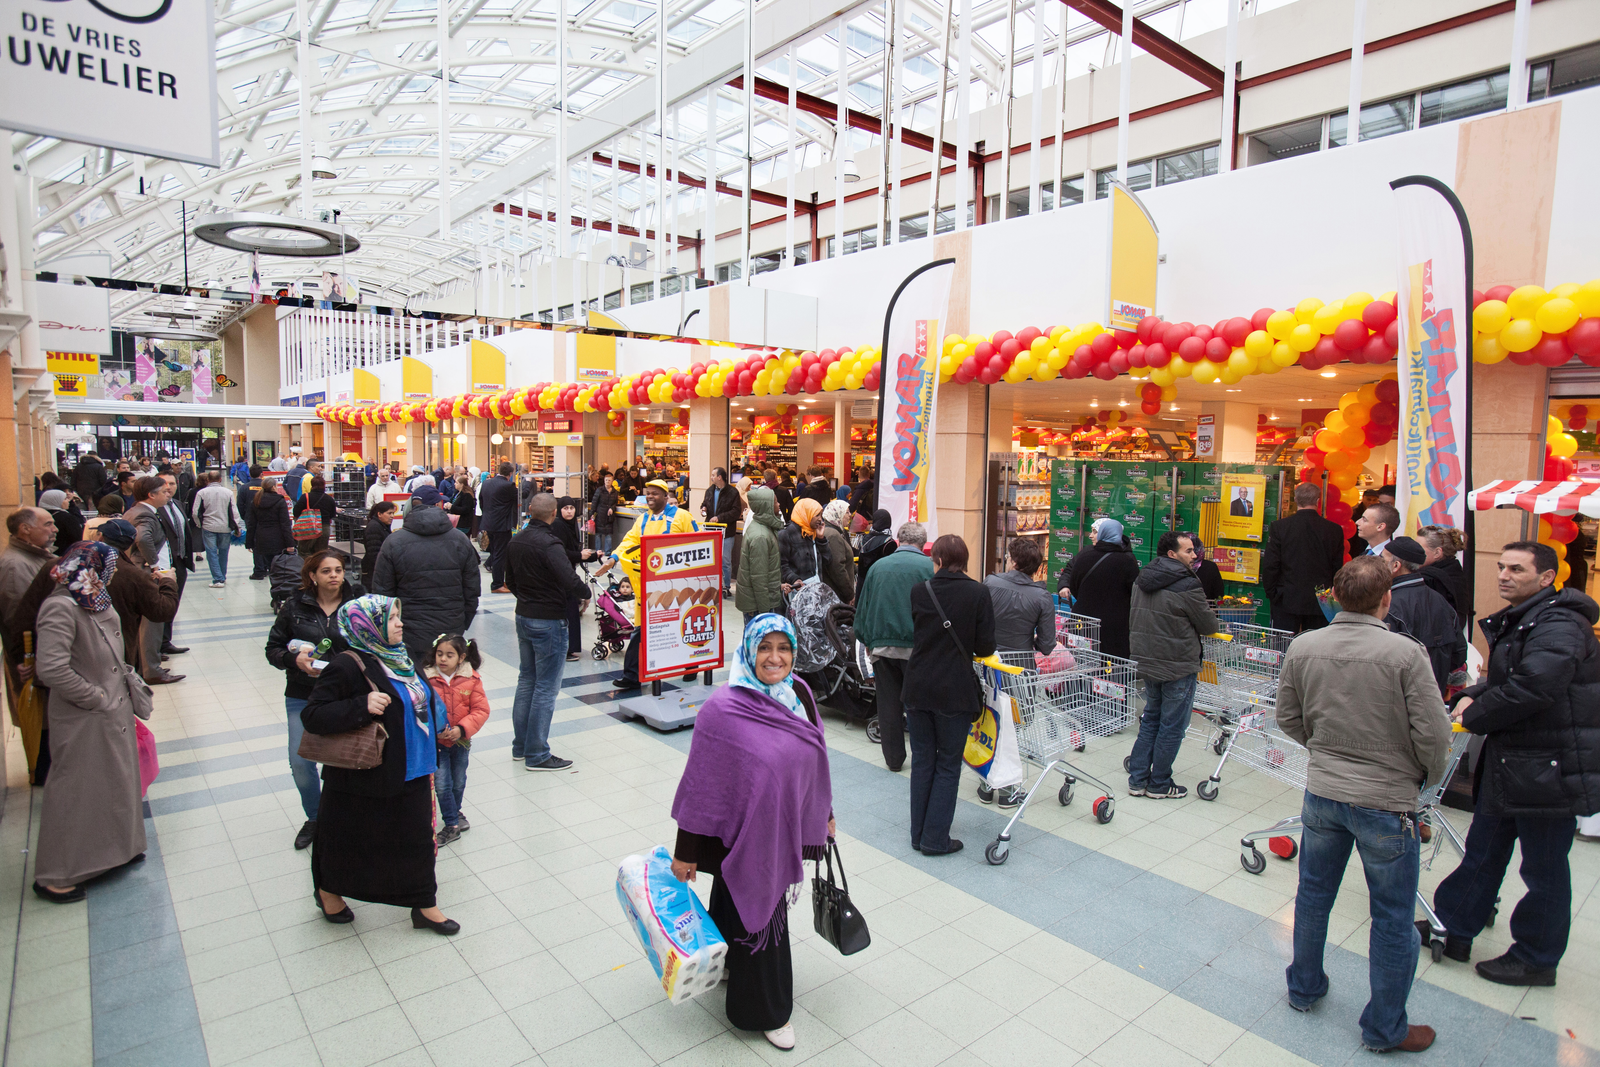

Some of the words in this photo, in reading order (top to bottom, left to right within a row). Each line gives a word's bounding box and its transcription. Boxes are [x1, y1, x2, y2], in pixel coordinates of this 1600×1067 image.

[22, 11, 56, 37] DE
[67, 23, 142, 58] VRIES
[0, 36, 179, 99] UWELIER
[1120, 303, 1147, 320] VOMAR
[891, 353, 927, 492] VOMAR
[665, 547, 710, 566] ACTIE!
[684, 613, 713, 635] 1+1
[683, 631, 715, 644] GRATIS
[968, 722, 993, 751] LIDL
